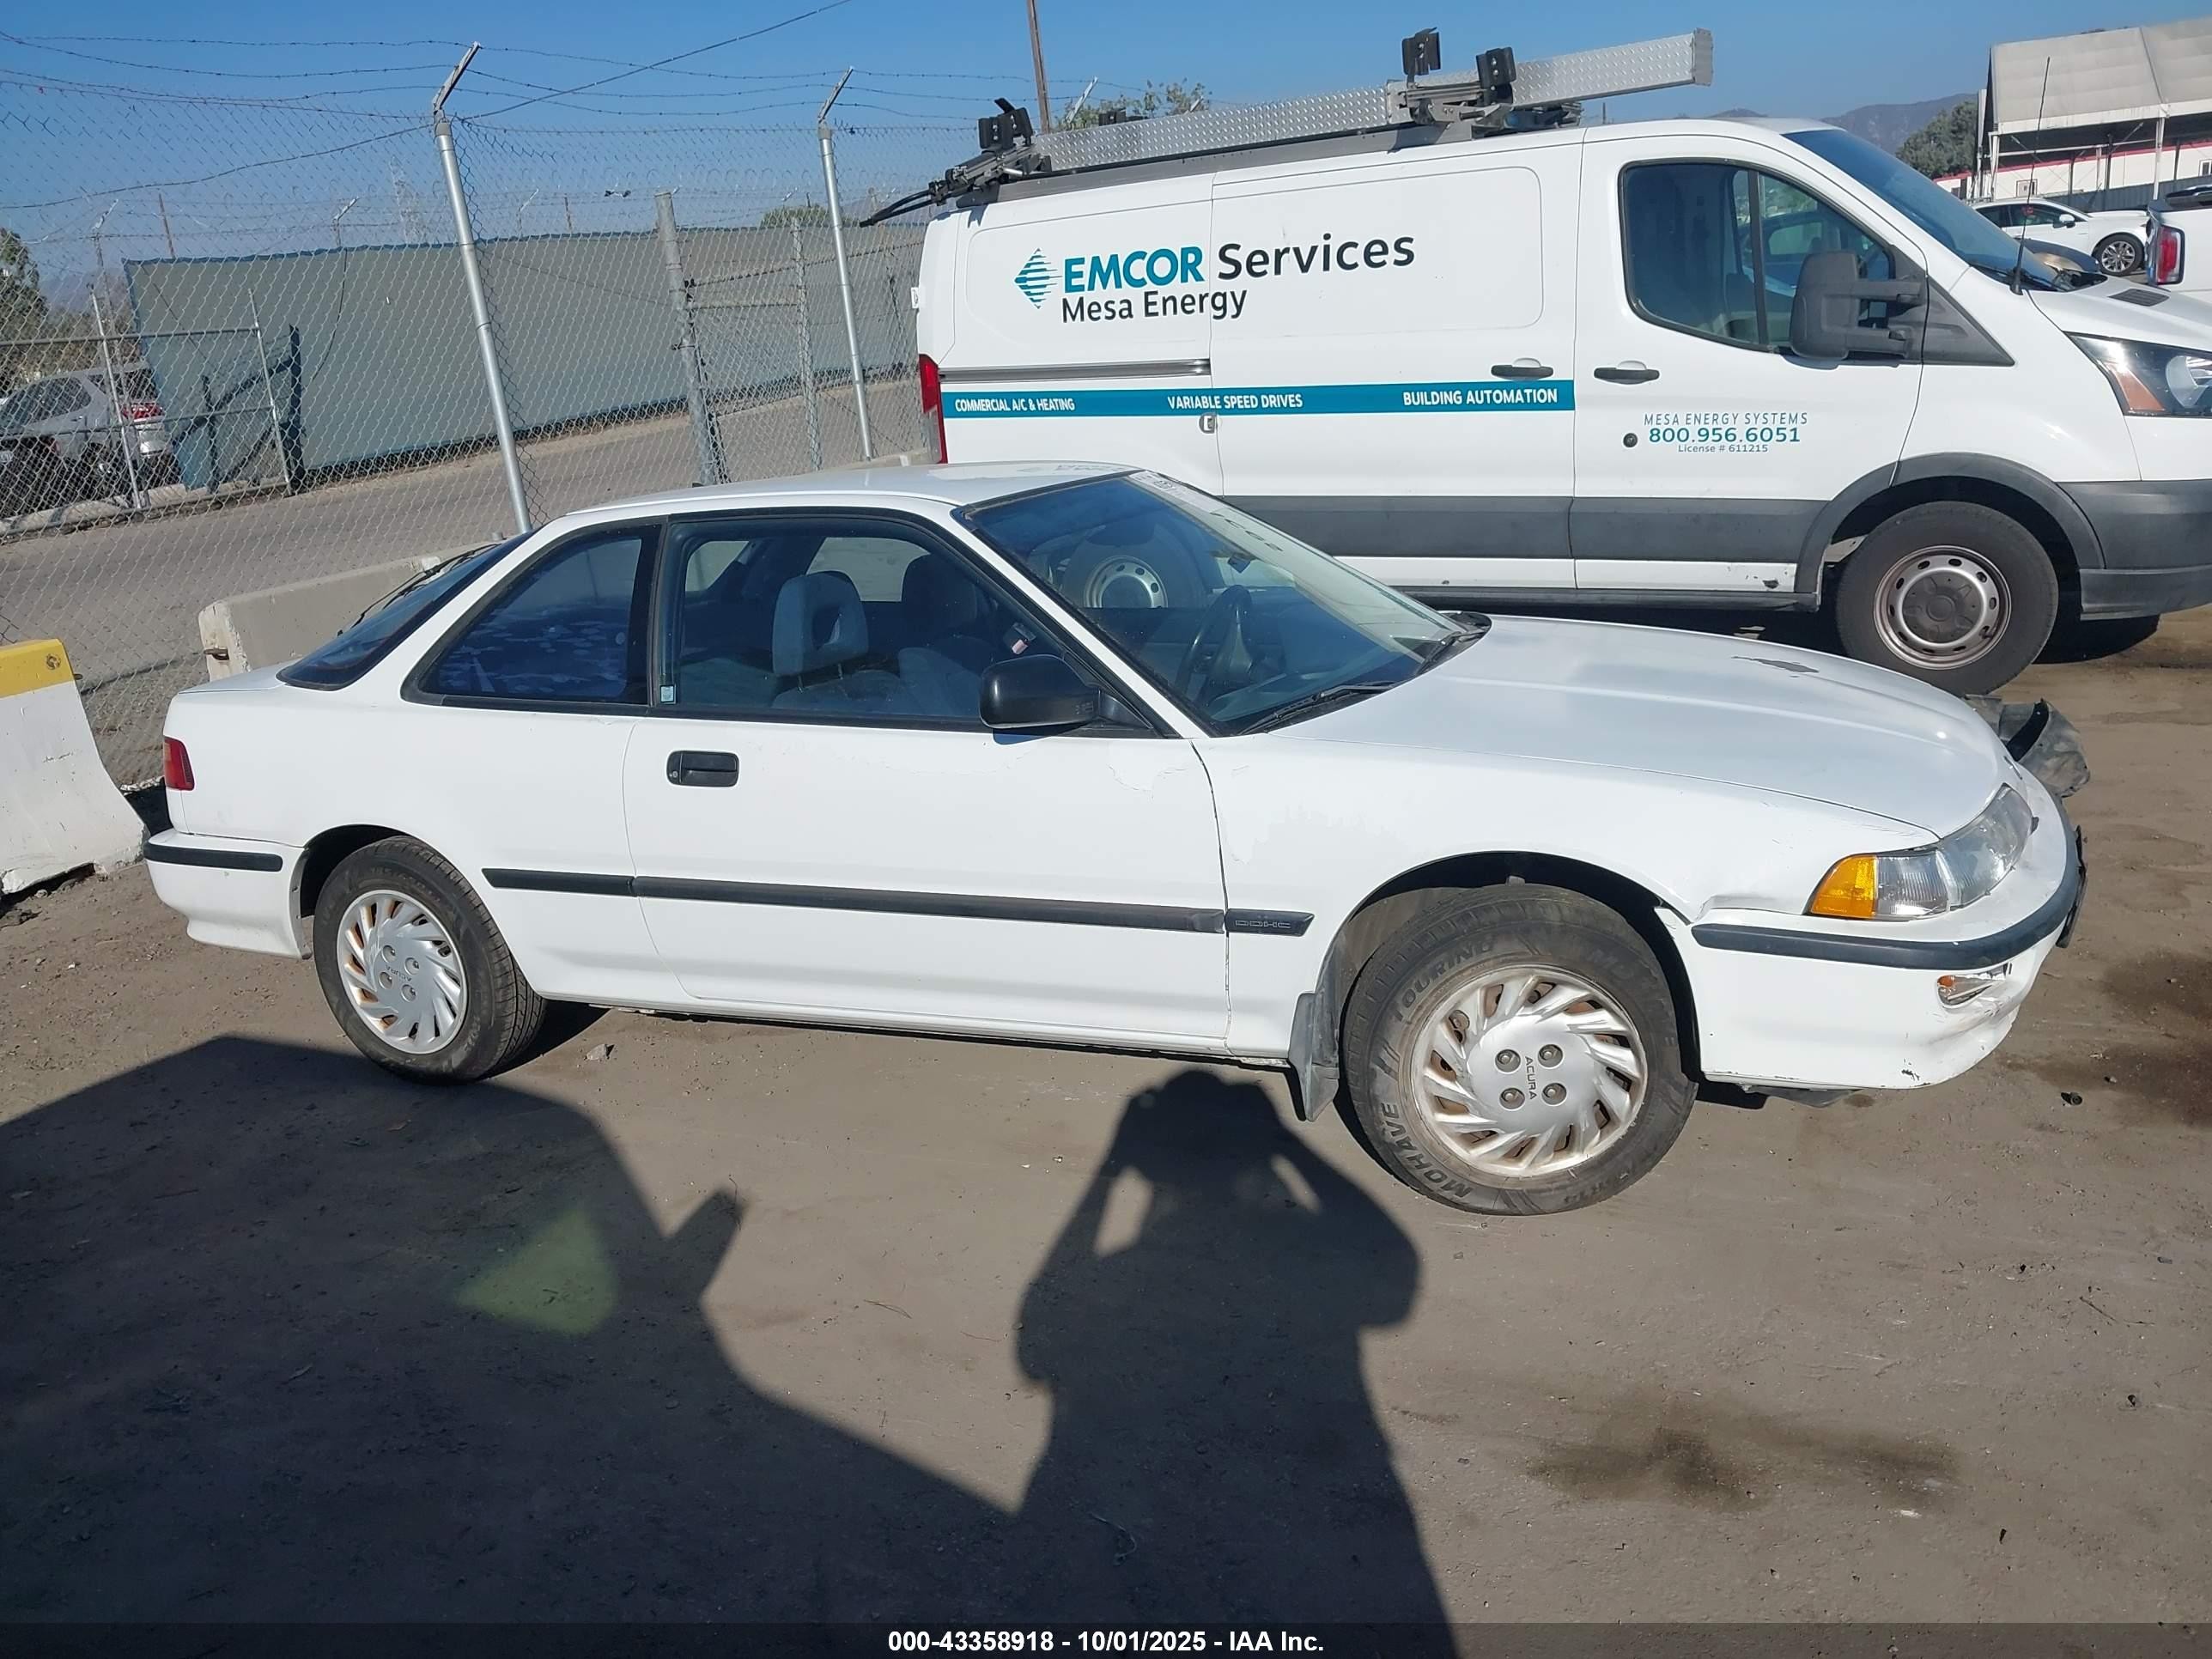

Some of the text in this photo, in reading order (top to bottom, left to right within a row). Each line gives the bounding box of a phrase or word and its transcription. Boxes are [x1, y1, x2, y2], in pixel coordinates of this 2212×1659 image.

[1064, 234, 1415, 294] EMCOR Services
[1062, 289, 1248, 323] Mesa Energy
[955, 398, 1075, 411] COMMERCIAL A/C & HEATING
[1168, 393, 1303, 409] VARIABLE SPEED DRIVES
[1403, 389, 1558, 405] BUILDING AUTOMATION
[1644, 412, 1808, 426] MESA ENERGY SYSTEMS
[1649, 428, 1800, 442] 800.956.6051
[1678, 444, 1768, 453] License # 611215
[1525, 1056, 1537, 1100] ACURA
[1381, 1103, 1474, 1198] MOHAVE
